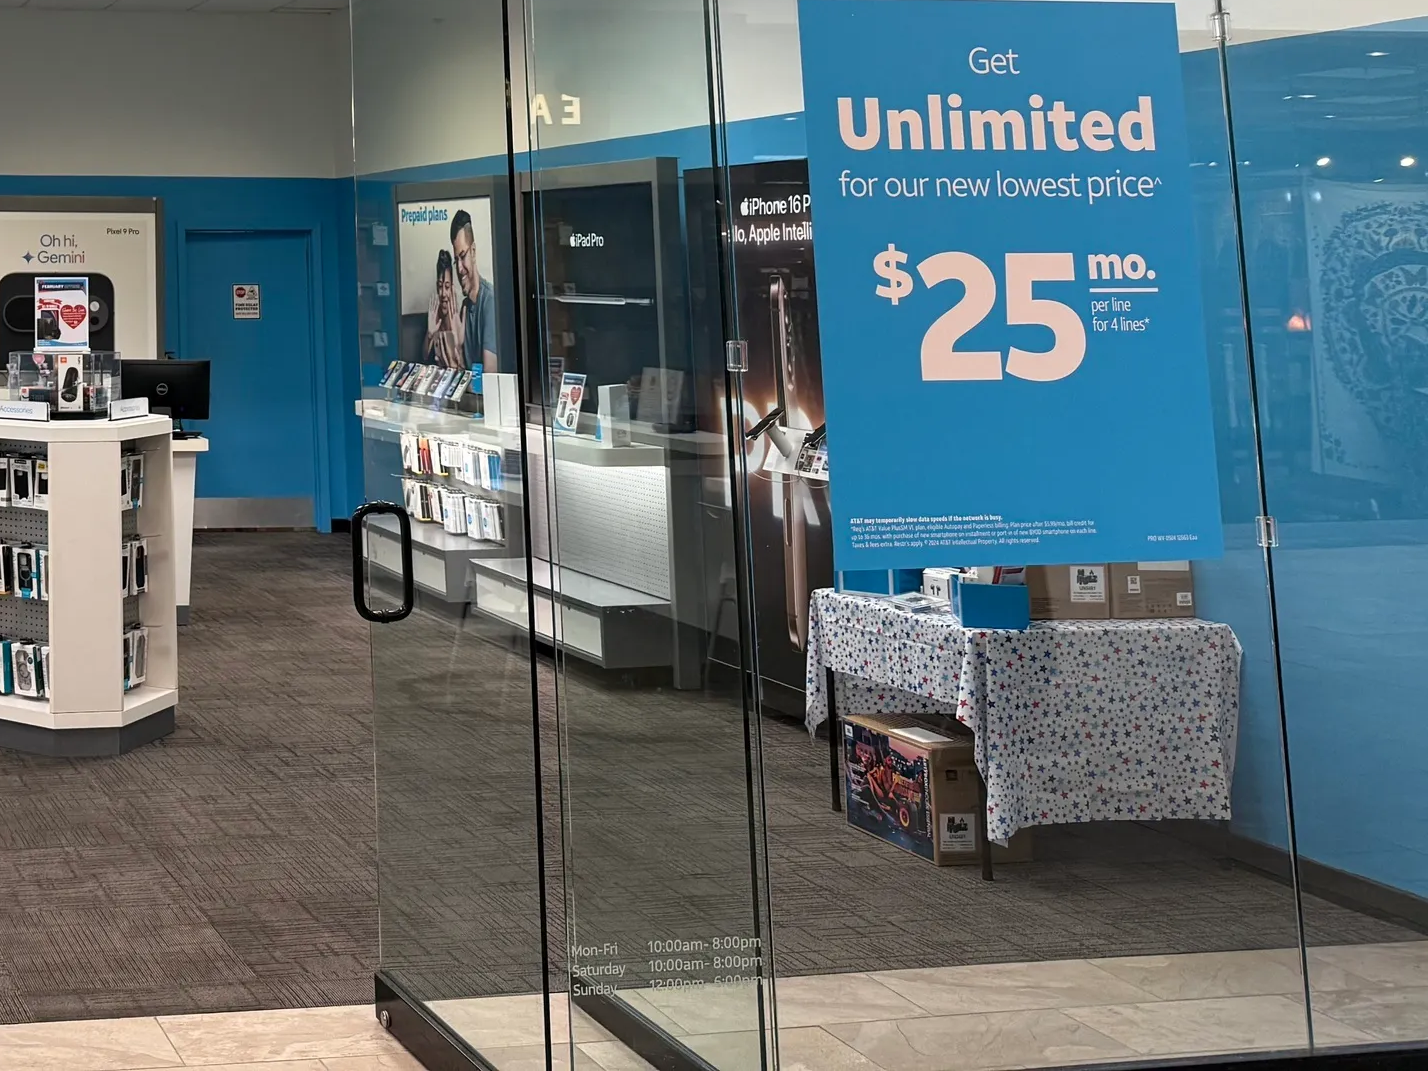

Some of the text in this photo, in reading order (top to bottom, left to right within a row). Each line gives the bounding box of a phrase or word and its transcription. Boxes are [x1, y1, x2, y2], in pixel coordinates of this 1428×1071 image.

[968, 47, 1020, 75] Get
[837, 94, 1156, 151] Unlimited
[839, 170, 878, 197] for
[884, 177, 929, 197] our
[936, 177, 990, 197] new
[996, 170, 1082, 197] lowest
[749, 197, 787, 216] iPhone
[788, 194, 801, 214] 16
[401, 206, 448, 226] Prepaid plans
[40, 234, 78, 248] Oh hi,
[575, 233, 604, 247] iPad Pro
[749, 223, 781, 246] Apple
[37, 250, 85, 264] Gemini
[1088, 253, 1156, 280] mo.
[873, 243, 1087, 382] $25
[1091, 297, 1131, 316] per line
[1093, 317, 1108, 331] for
[1111, 318, 1118, 331] 4
[0, 404, 33, 415] Accessories
[571, 942, 618, 957] Mon-Fri
[712, 936, 762, 951] 8:00pm
[572, 962, 626, 977] Saturday
[713, 955, 763, 970] 8:00pm
[573, 982, 618, 997] Sunday
